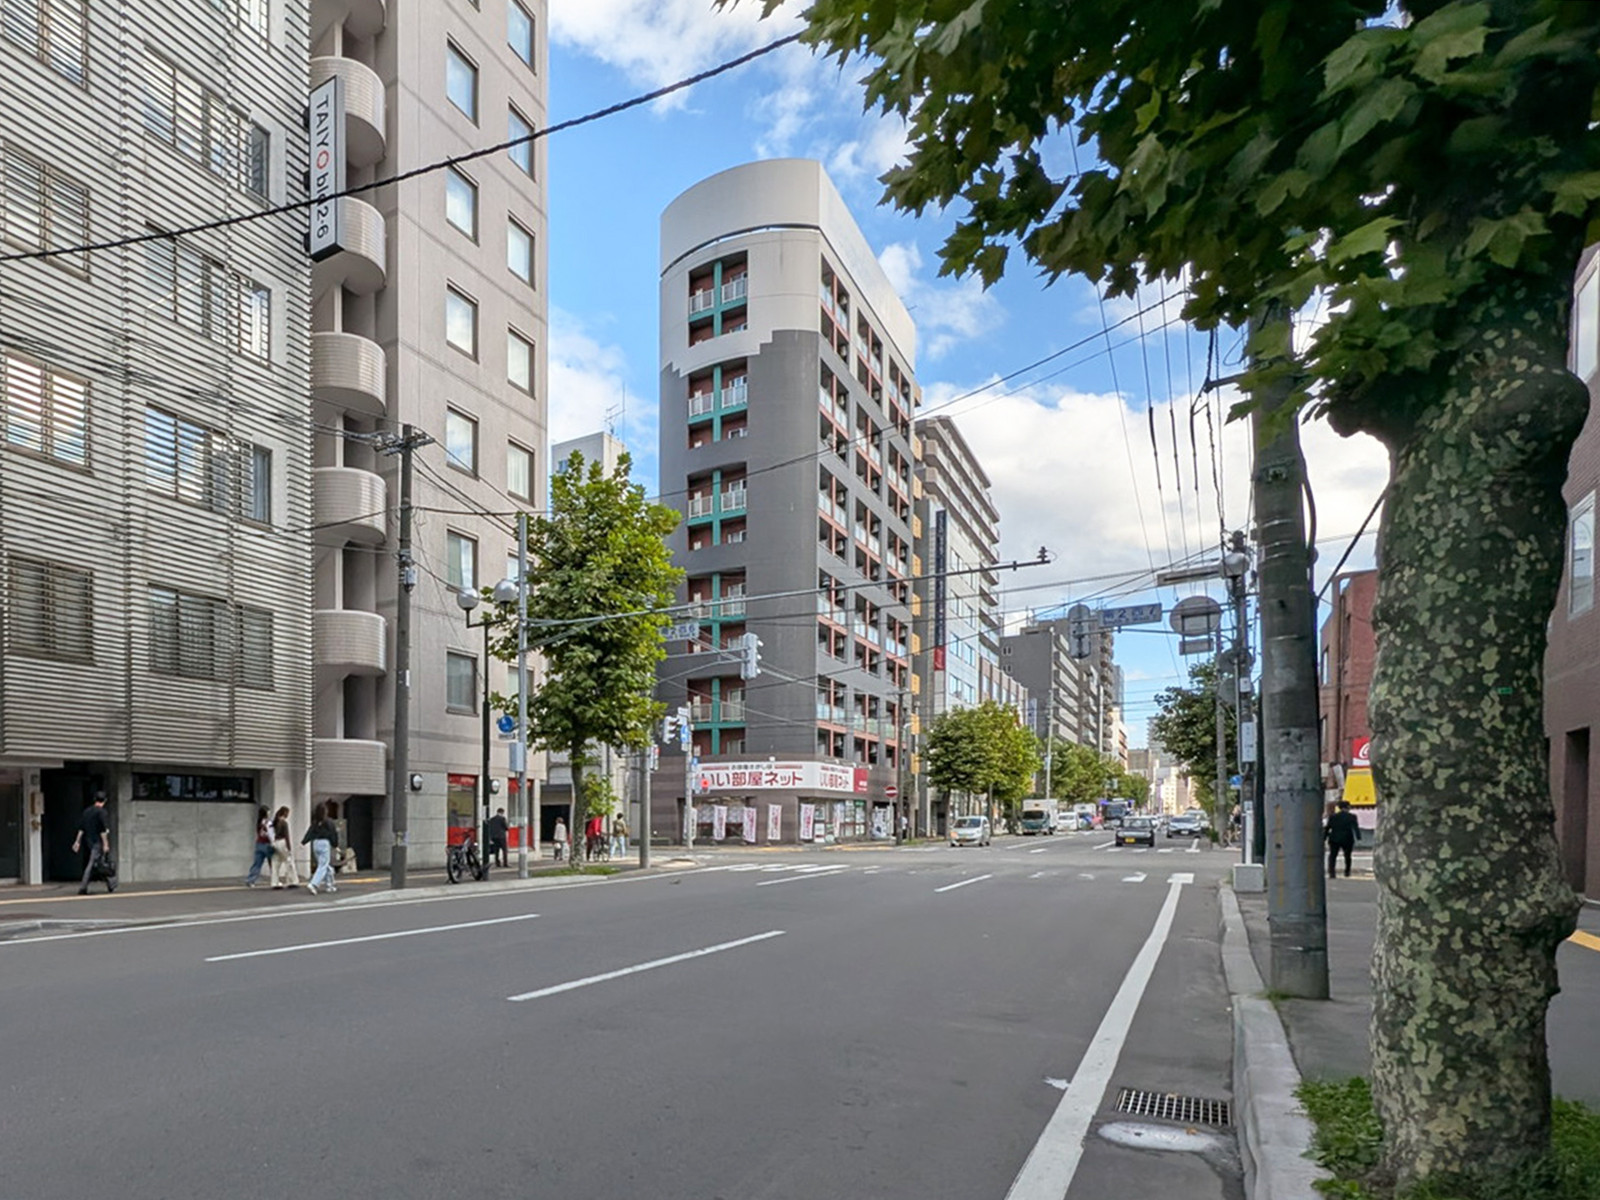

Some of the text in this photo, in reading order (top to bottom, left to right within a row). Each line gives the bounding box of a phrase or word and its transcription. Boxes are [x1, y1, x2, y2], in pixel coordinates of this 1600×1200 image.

[316, 94, 329, 169] TAIYO
[702, 771, 803, 787] いい部屋ネット
